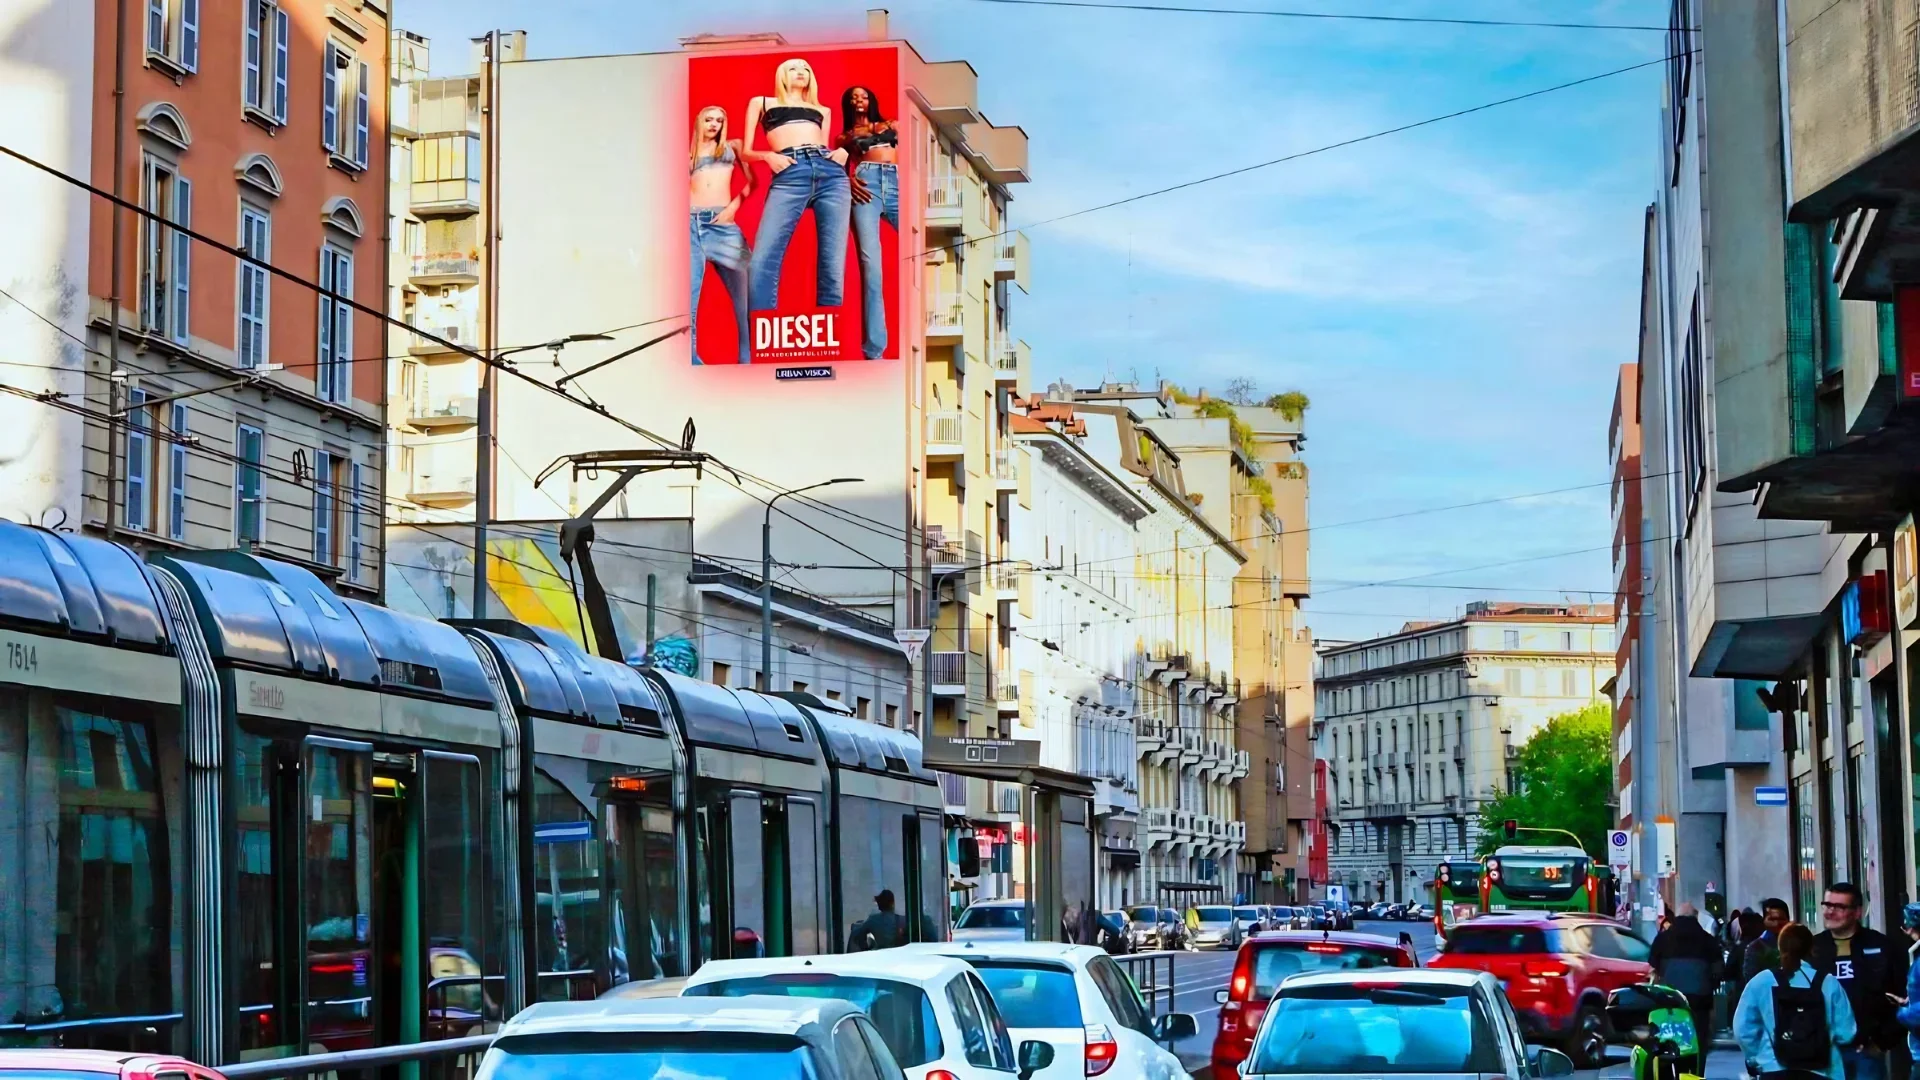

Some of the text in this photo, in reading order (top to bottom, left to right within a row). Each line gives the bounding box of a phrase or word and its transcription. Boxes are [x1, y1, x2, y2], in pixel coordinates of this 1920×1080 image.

[756, 314, 840, 350] DIESEL
[776, 369, 831, 378] URBAN VISION
[7, 641, 38, 674] 7514
